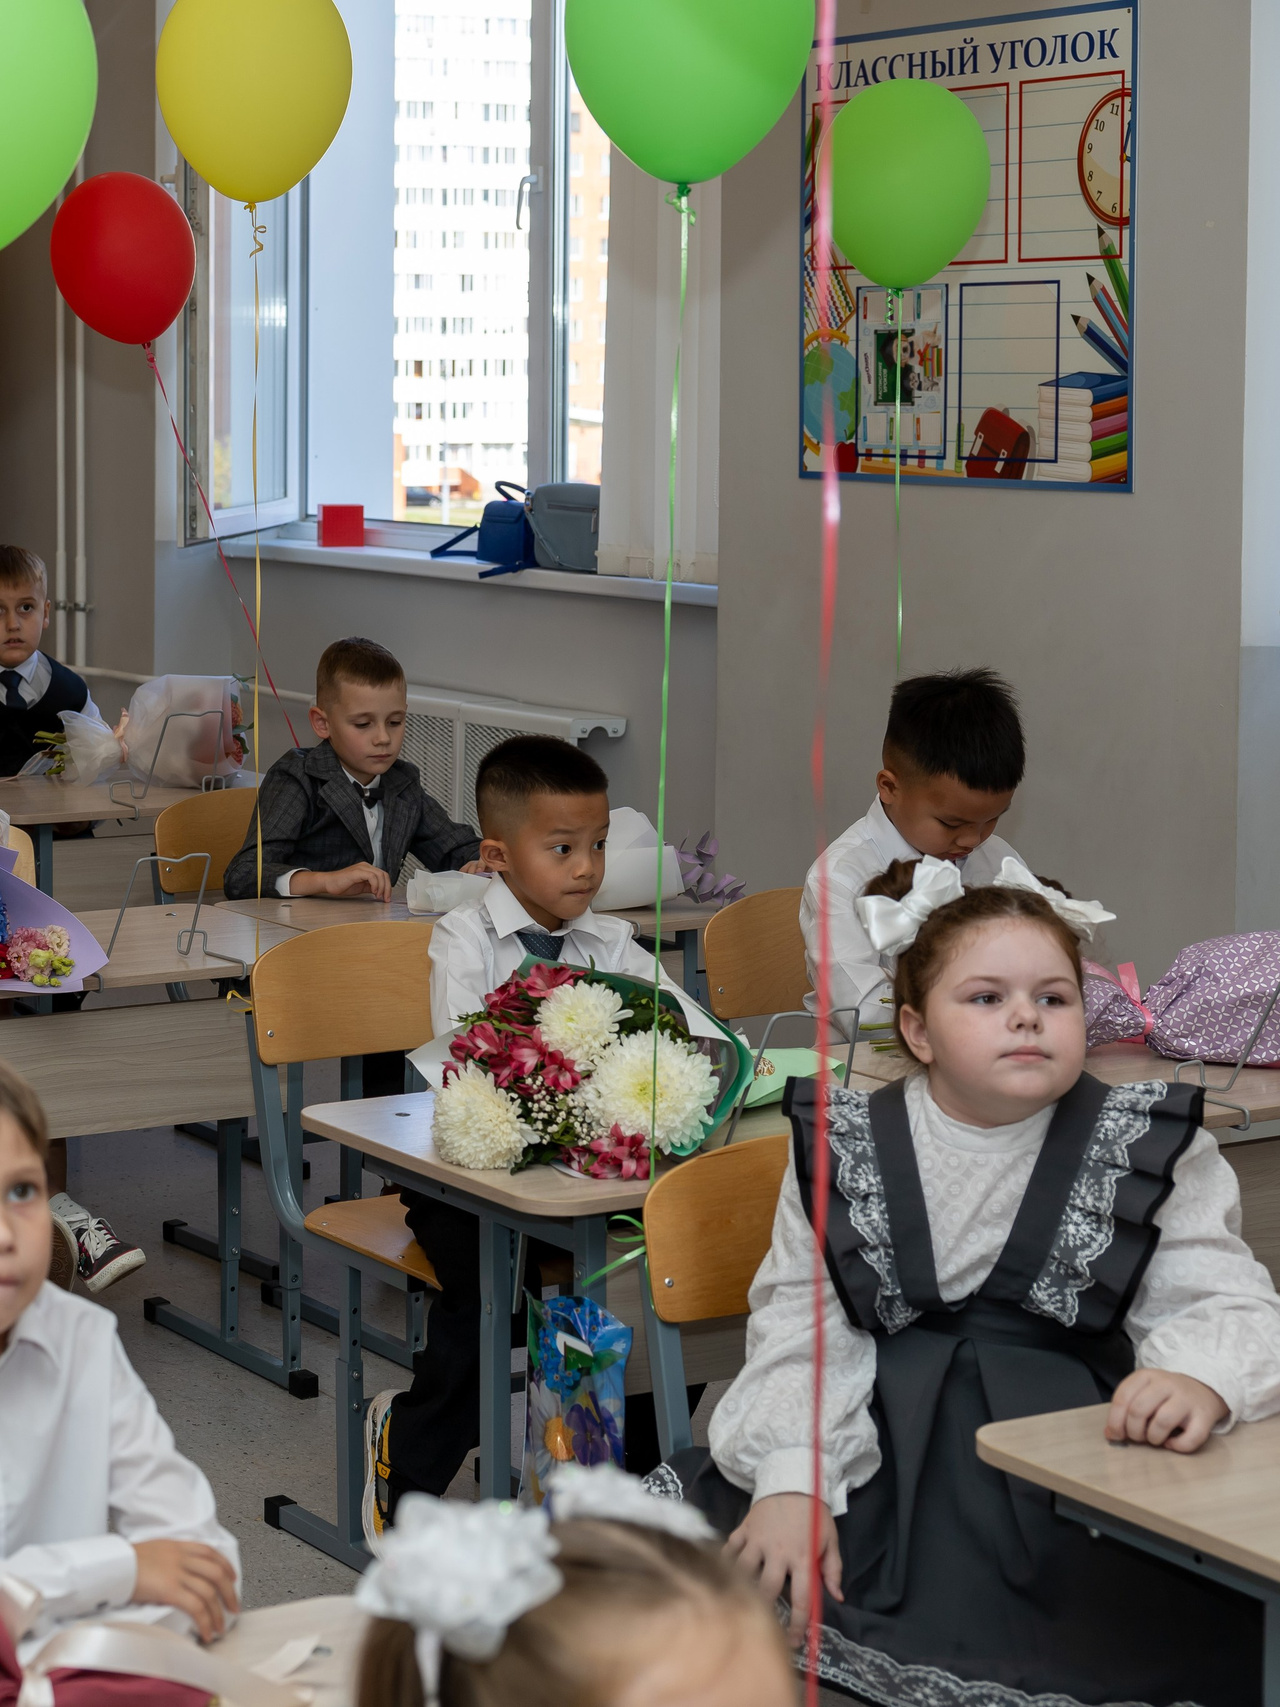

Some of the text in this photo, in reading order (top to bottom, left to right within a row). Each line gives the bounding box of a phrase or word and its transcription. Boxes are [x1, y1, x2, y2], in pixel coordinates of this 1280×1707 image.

[986, 28, 1120, 73] УГОЛОК
[1109, 103, 1120, 116] 11
[1094, 119, 1105, 132] 10
[1087, 142, 1093, 154] 9
[1087, 170, 1093, 182] 8
[1096, 190, 1102, 201] 7
[1111, 202, 1117, 213] 6
